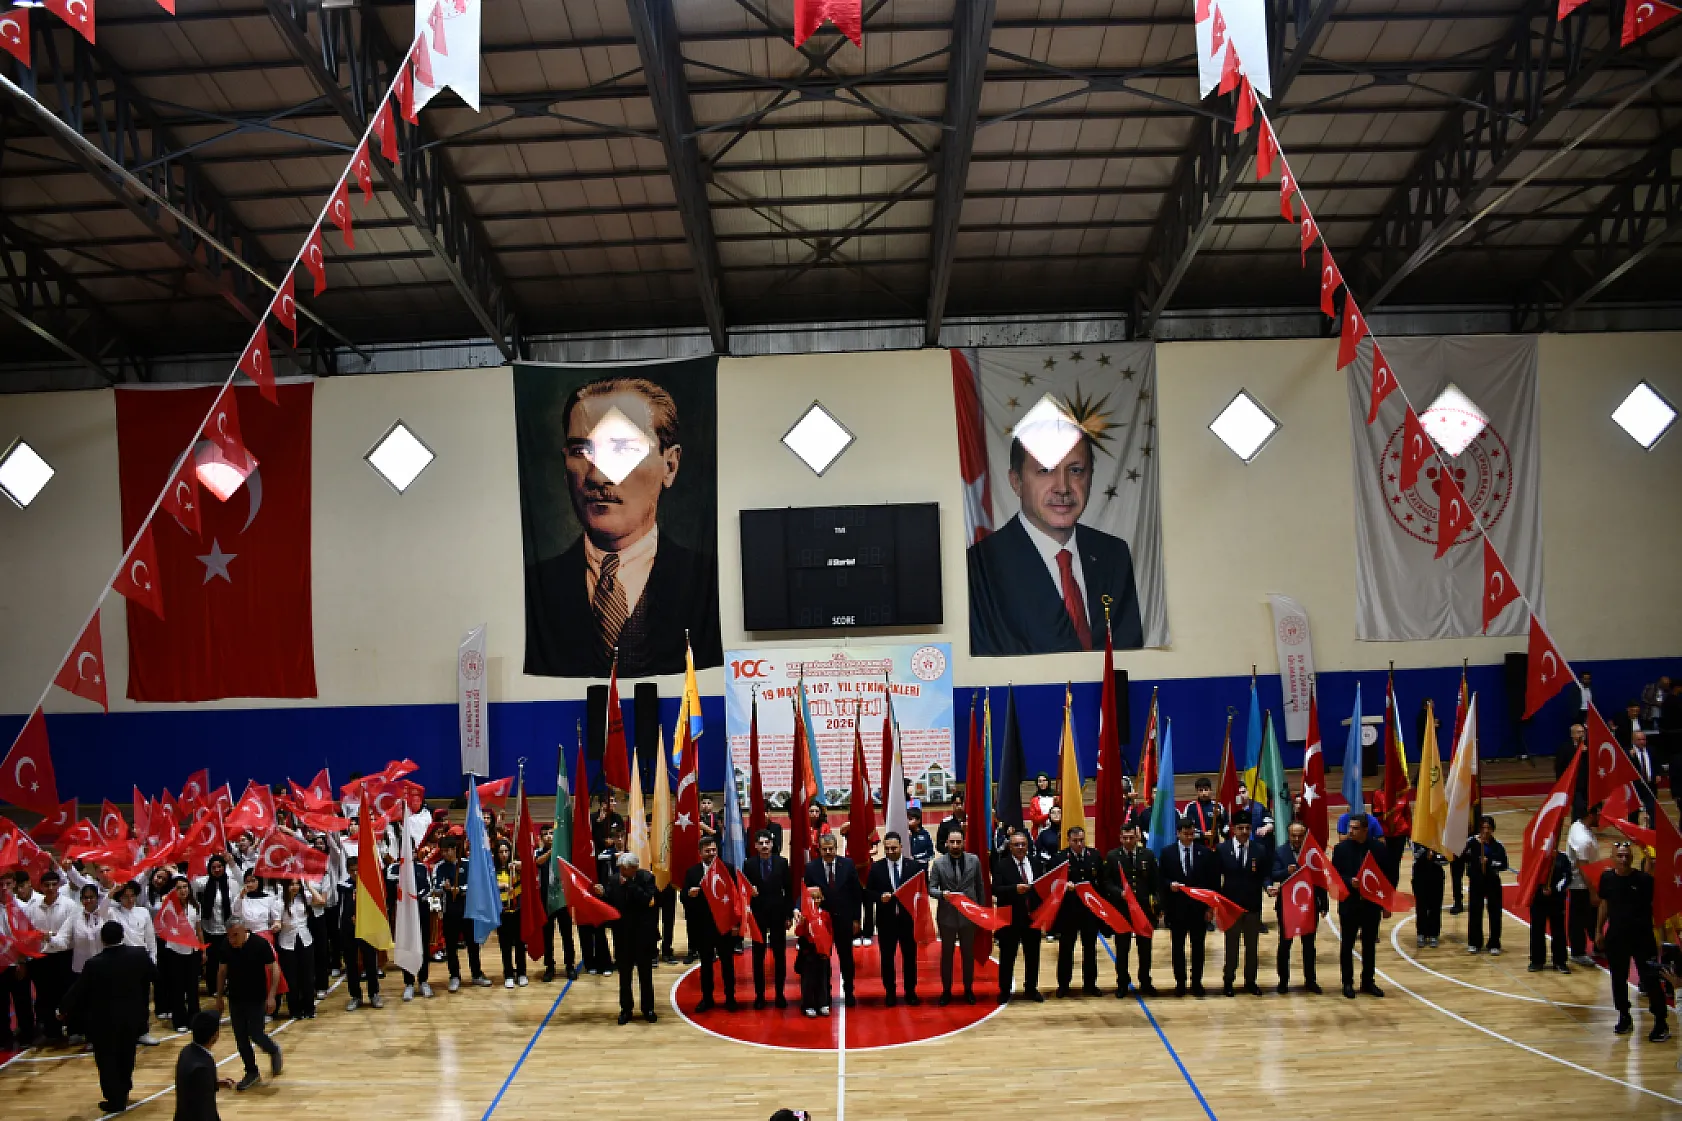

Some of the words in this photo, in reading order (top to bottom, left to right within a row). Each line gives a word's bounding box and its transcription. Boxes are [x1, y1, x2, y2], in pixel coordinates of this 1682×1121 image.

[831, 615, 856, 625] SCORE
[762, 689, 774, 700] 19
[776, 684, 809, 699] MAYS
[812, 683, 833, 694] 107.
[837, 682, 852, 692] YIL
[855, 681, 920, 697] ETKİNİKLERİ
[826, 719, 854, 730] 2026
